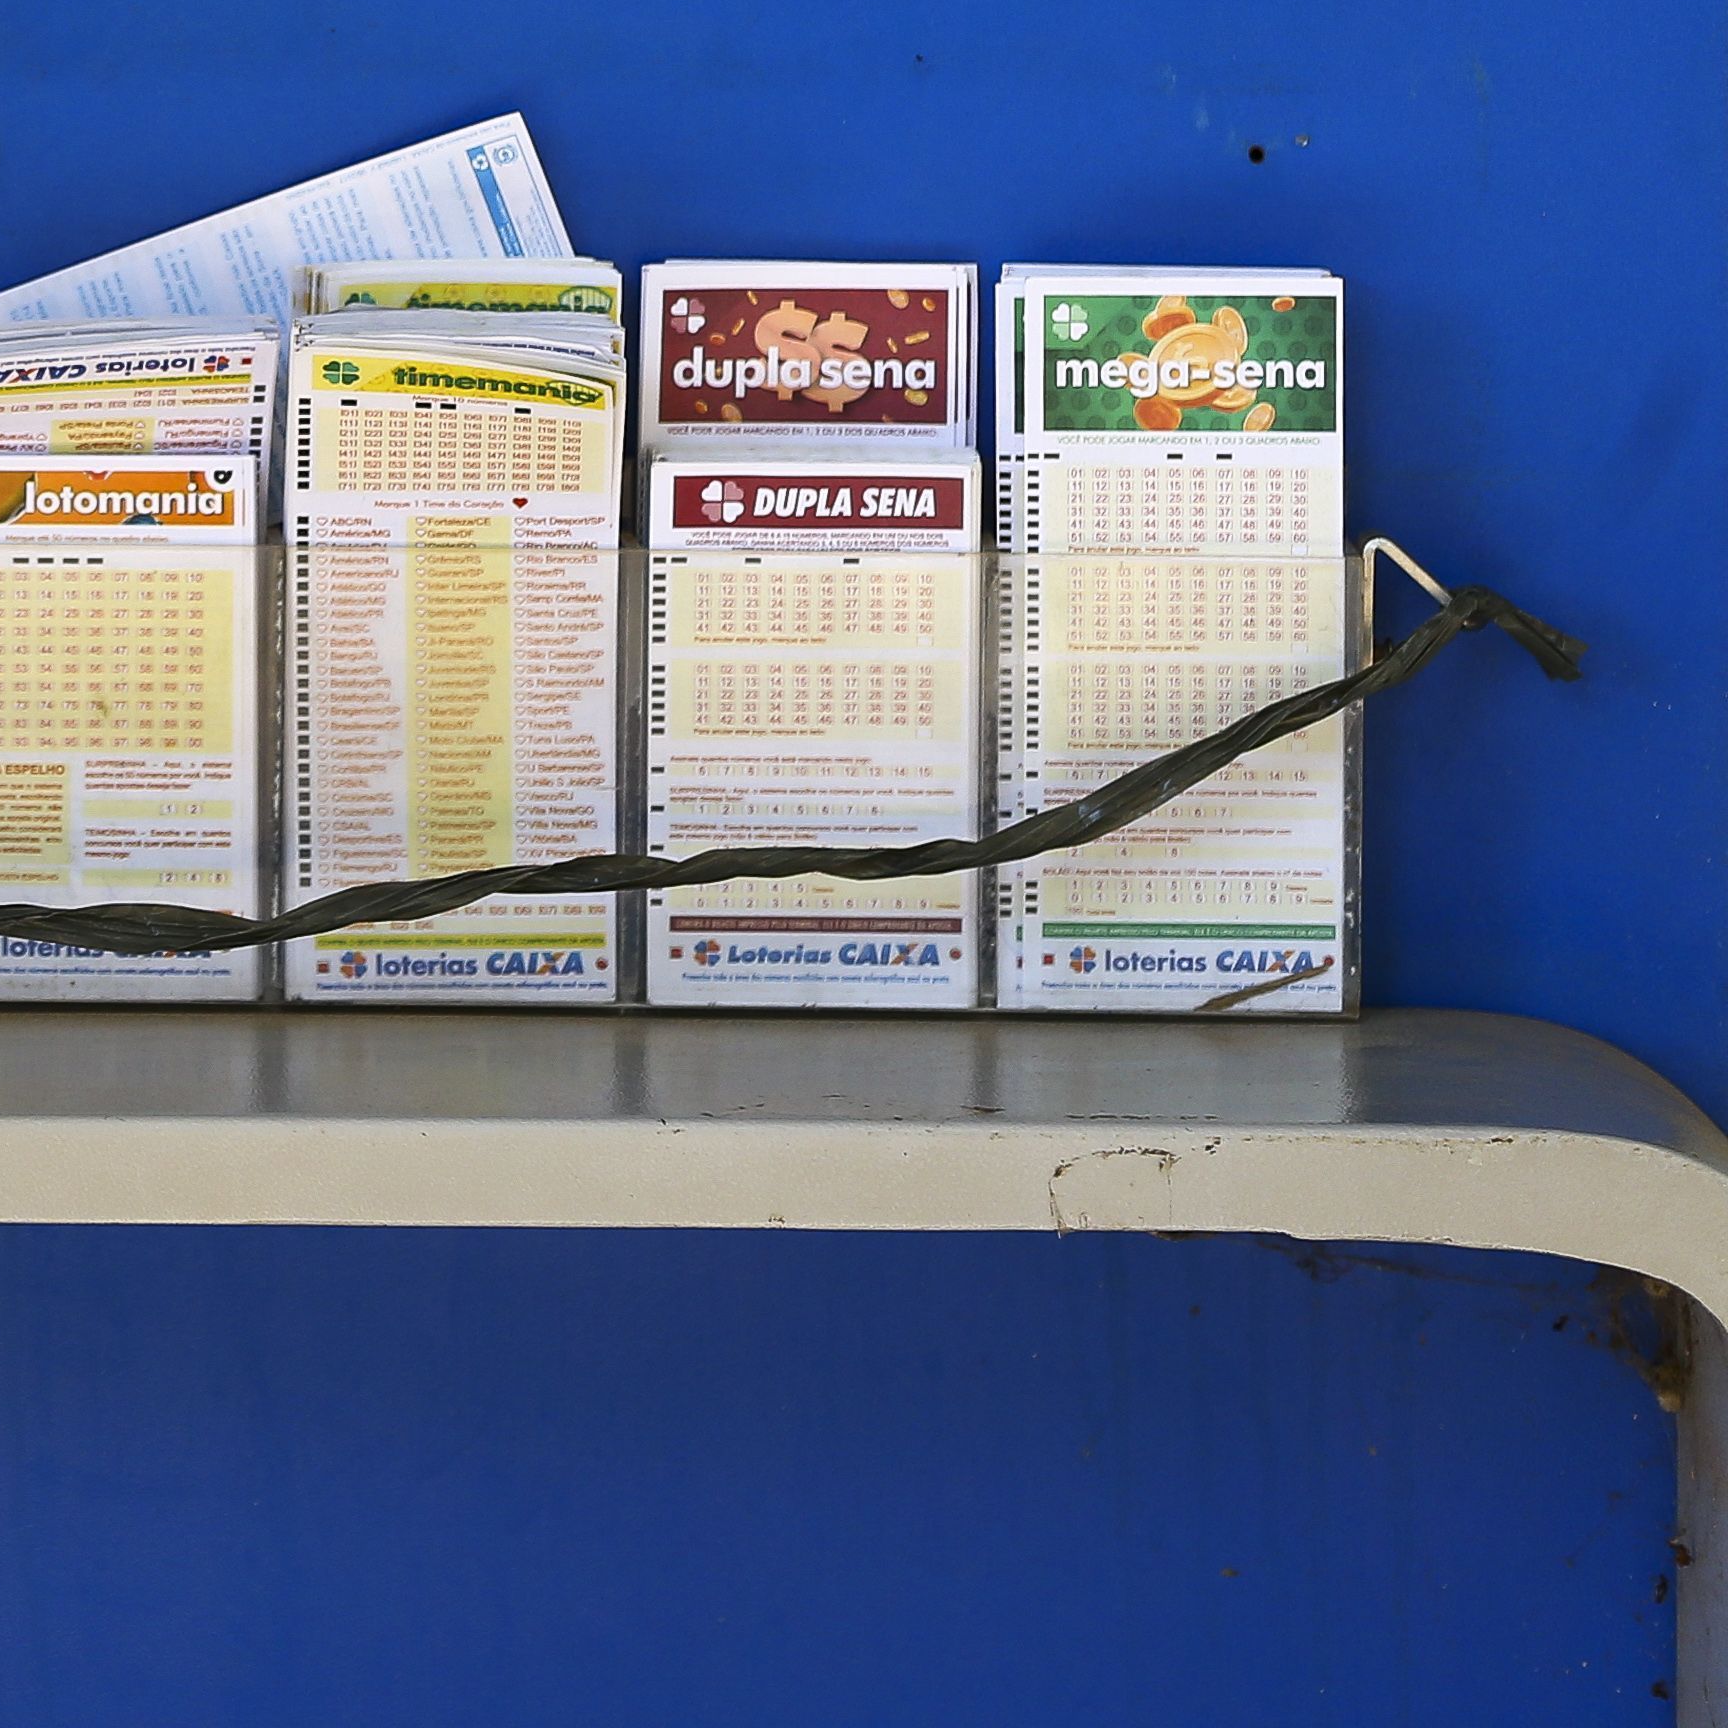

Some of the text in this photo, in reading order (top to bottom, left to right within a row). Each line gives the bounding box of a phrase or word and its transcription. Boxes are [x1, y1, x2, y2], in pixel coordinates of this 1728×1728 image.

[95, 356, 196, 375] loterias
[673, 346, 935, 398] dupla sena
[1056, 358, 1325, 399] mega-sena
[394, 367, 596, 403] timemania
[25, 481, 224, 516] lotomania
[753, 487, 936, 518] DUPLA SENA
[5, 764, 65, 776] ESPELHO
[376, 951, 583, 977] loterias CAIXA
[727, 943, 939, 966] Loterias CAIXA
[1105, 948, 1316, 973] loterias CAIXA
